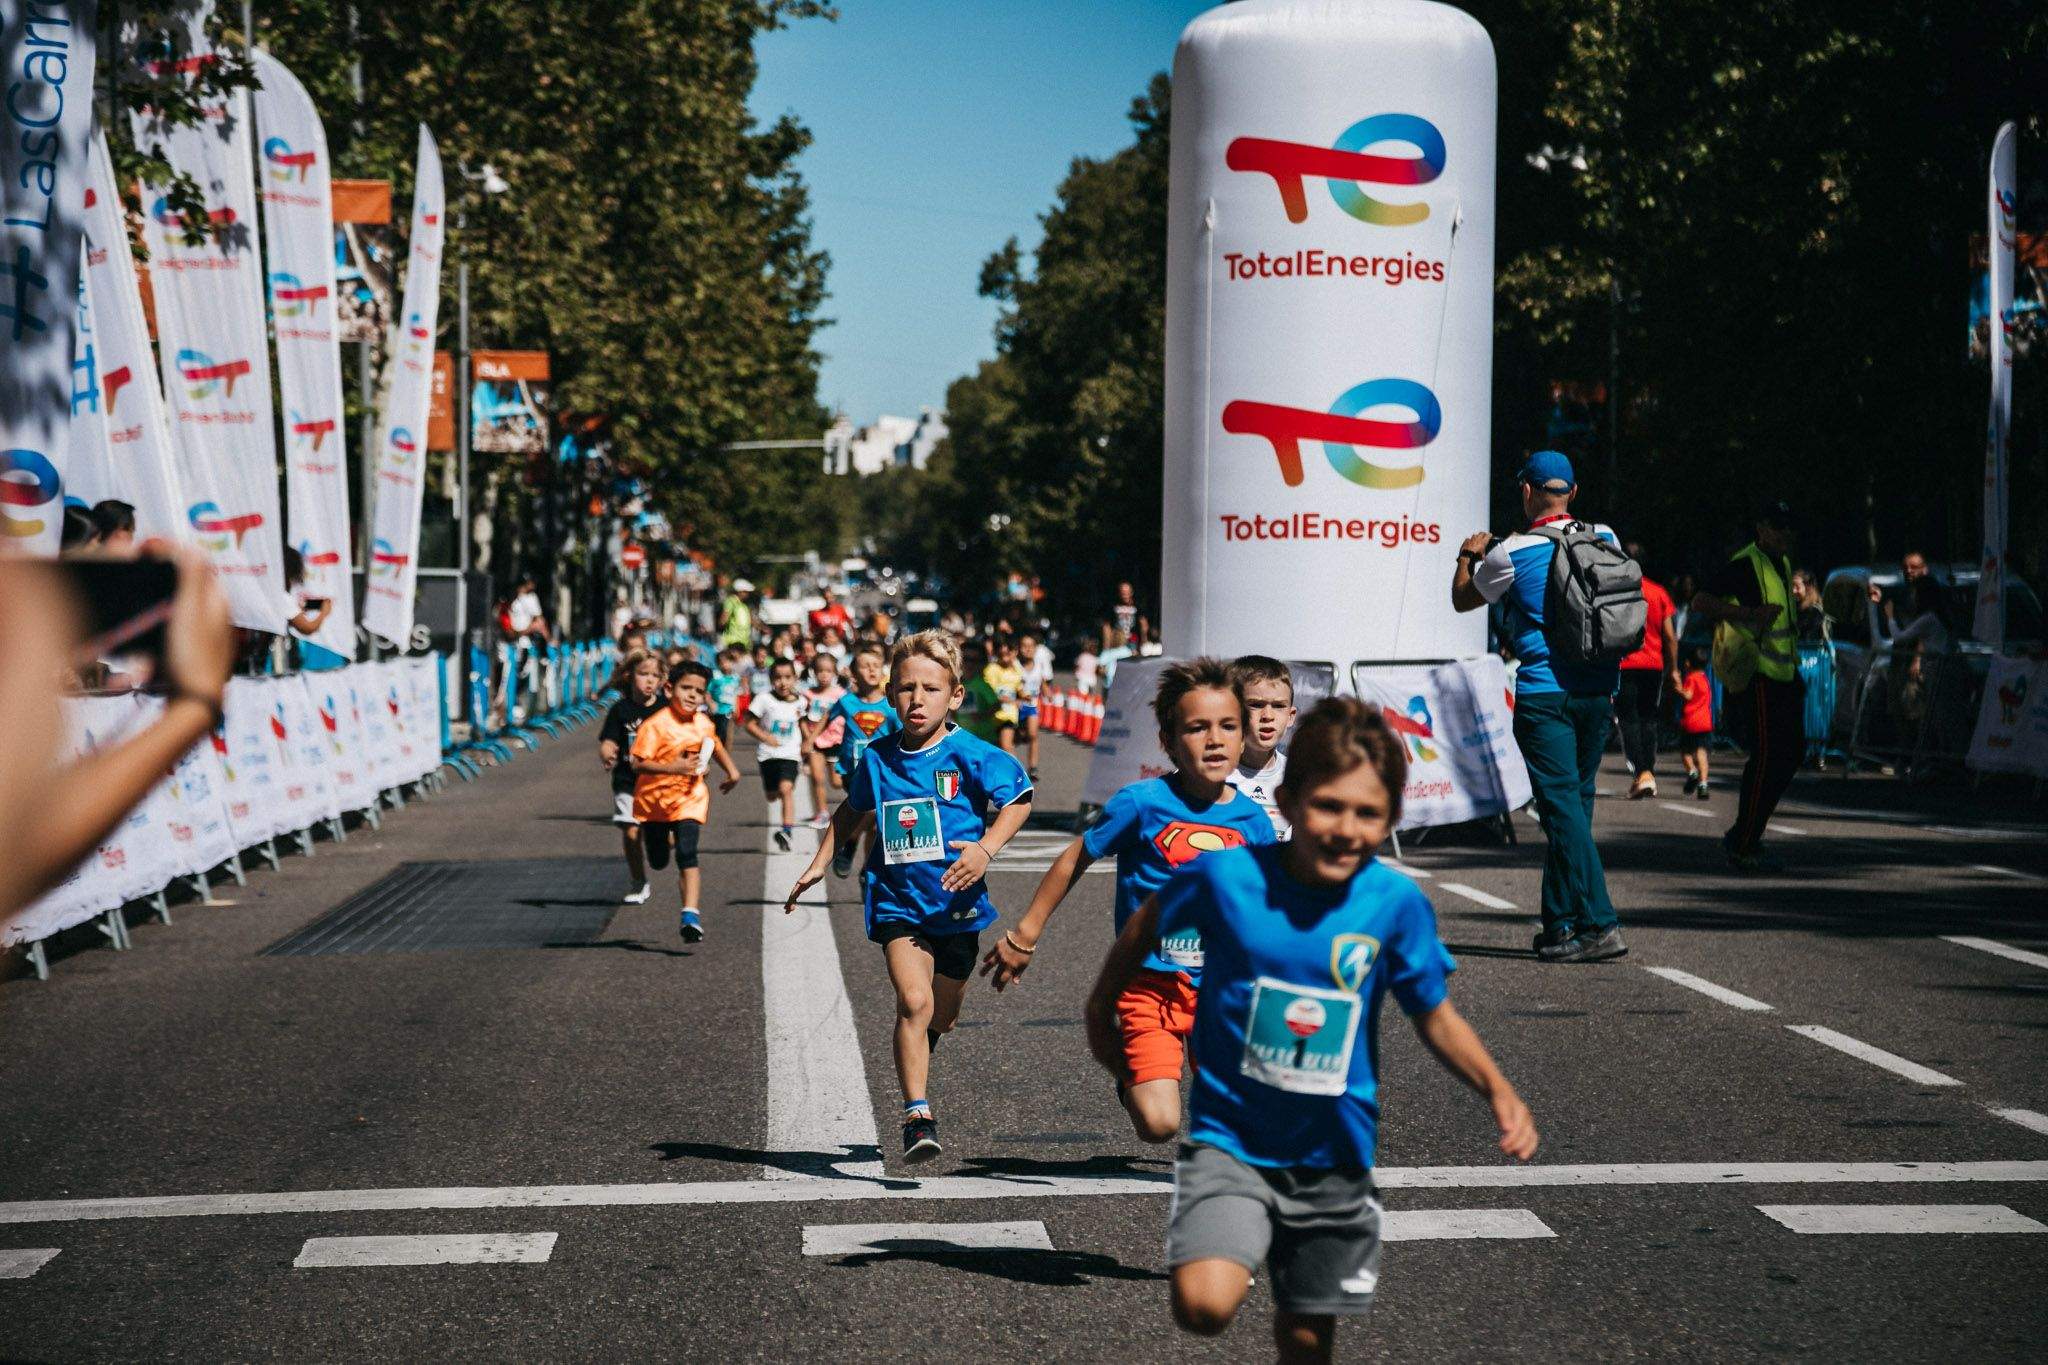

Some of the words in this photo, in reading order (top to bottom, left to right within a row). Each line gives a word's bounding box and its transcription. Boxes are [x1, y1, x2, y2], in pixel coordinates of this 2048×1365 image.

[0, 0, 70, 340] #LasCarr
[1223, 250, 1445, 285] TotalEnergies
[1220, 513, 1442, 548] TotalEnergies
[906, 829, 915, 848] 1
[1293, 1038, 1307, 1068] 1
